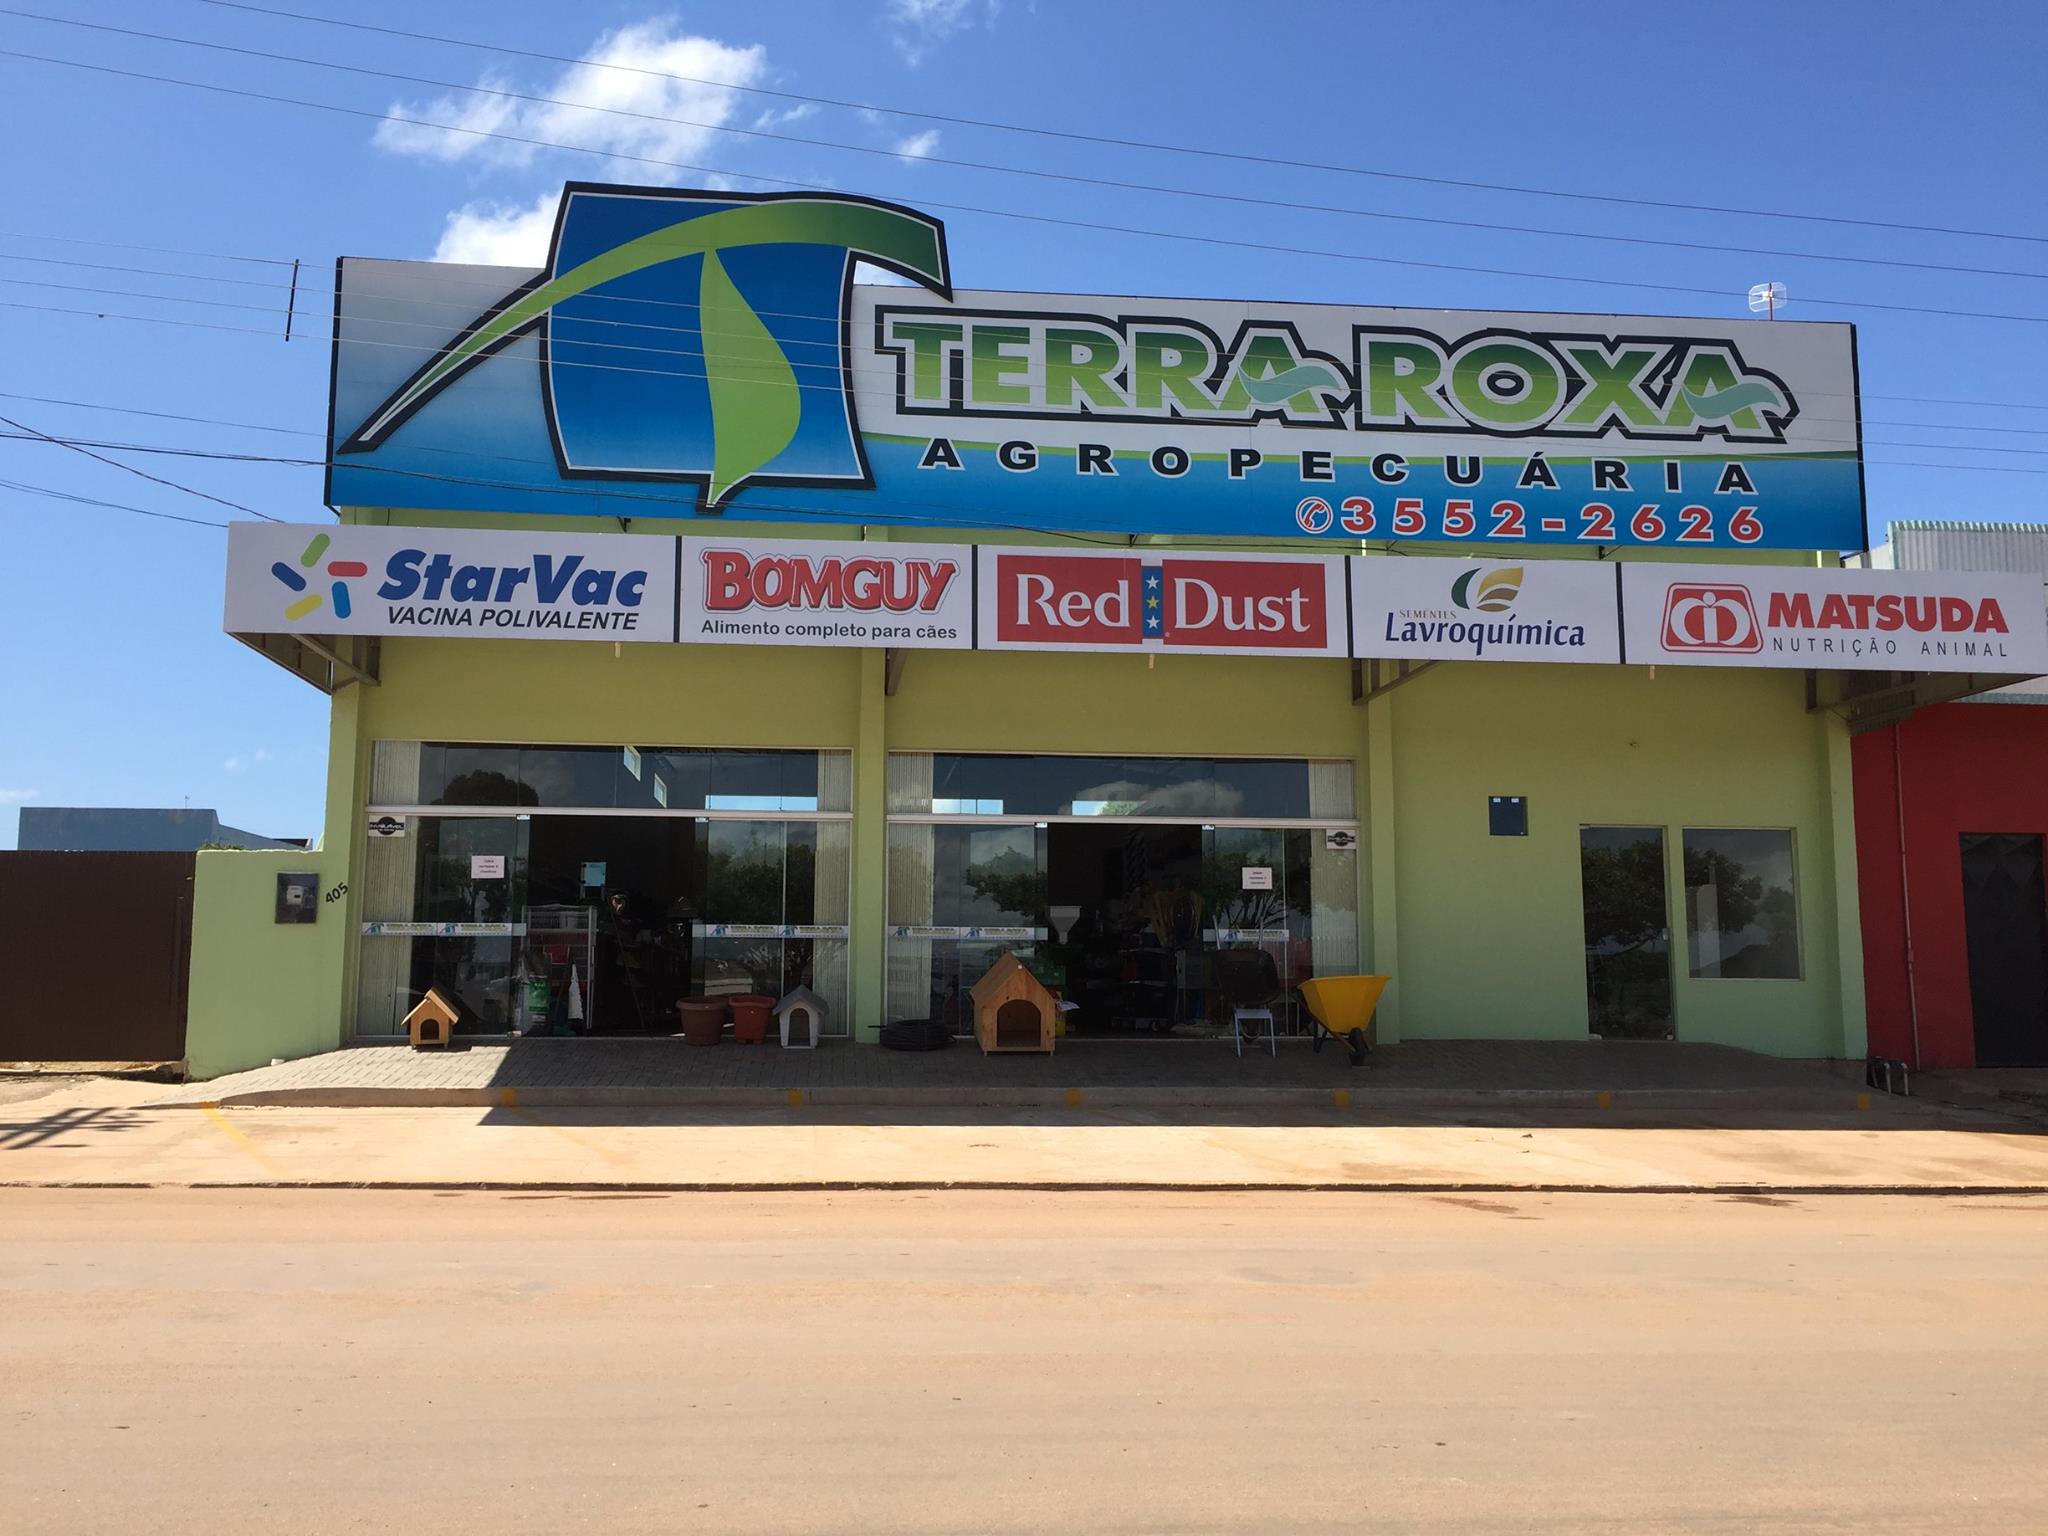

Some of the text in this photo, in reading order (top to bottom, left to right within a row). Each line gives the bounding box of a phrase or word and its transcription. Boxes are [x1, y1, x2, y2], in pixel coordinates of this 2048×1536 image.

[884, 314, 1788, 434] TERRA ROXA
[919, 437, 1758, 495] AGROPECUÁRIA
[1341, 497, 1764, 544] 3552-2626
[377, 549, 648, 606] StarVac
[703, 550, 956, 612] BOMGUY
[388, 606, 639, 630] VACINA POLIVALENTE
[1016, 573, 1311, 632] Red Dust
[1767, 592, 2010, 633] MATSUDA
[701, 619, 957, 640] Alimento completo para cães
[1385, 612, 1586, 656] Lavroquímica
[1773, 636, 2008, 657] NUTRIÇÃO ANIMAL
[326, 881, 348, 903] 405
